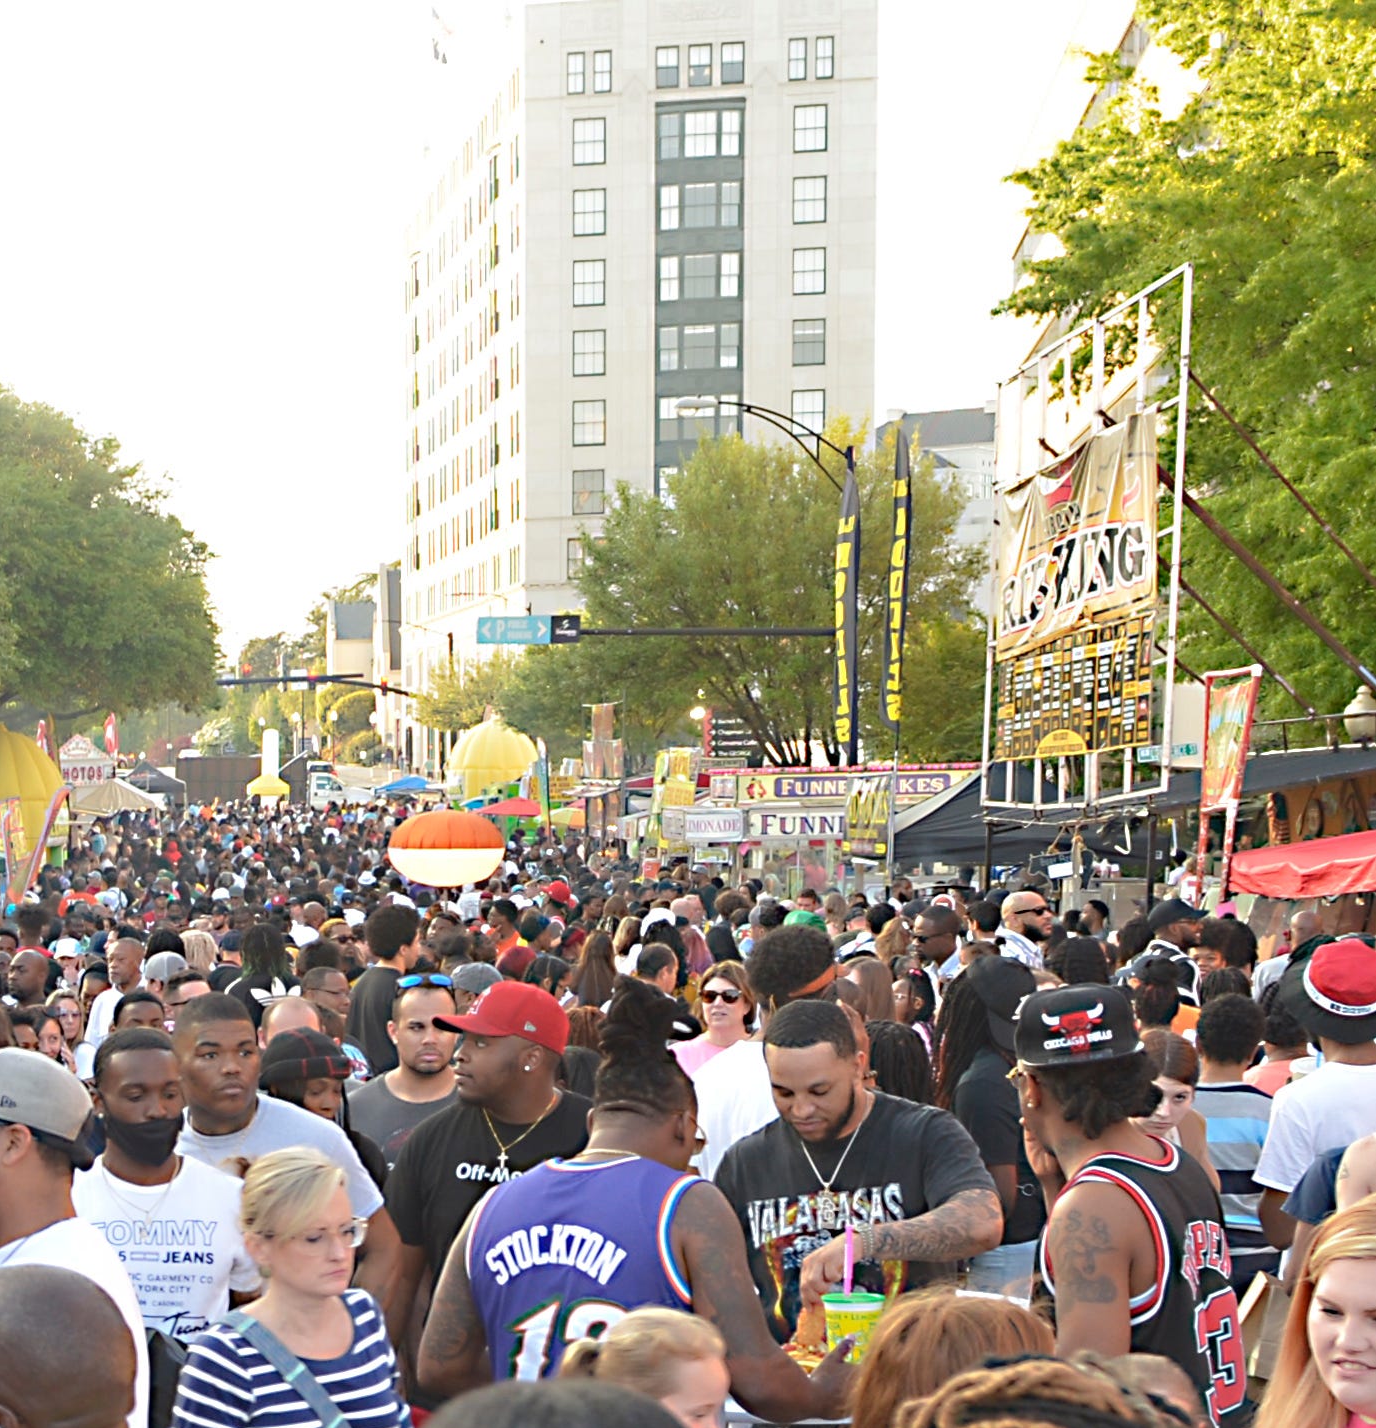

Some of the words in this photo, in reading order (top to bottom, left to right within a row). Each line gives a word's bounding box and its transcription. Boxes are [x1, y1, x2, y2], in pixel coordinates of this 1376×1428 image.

[779, 778, 847, 797] FUNNE
[1043, 1034, 1086, 1050] CHICAGO
[1085, 1029, 1114, 1043] BULLS
[455, 1161, 526, 1183] Off-Mo
[162, 1250, 215, 1265] JEANS
[485, 1222, 628, 1287] STOCKTON
[147, 1273, 196, 1283] GARMENT
[199, 1275, 214, 1284] CO
[138, 1284, 165, 1293] YORK
[168, 1285, 191, 1294] CITY
